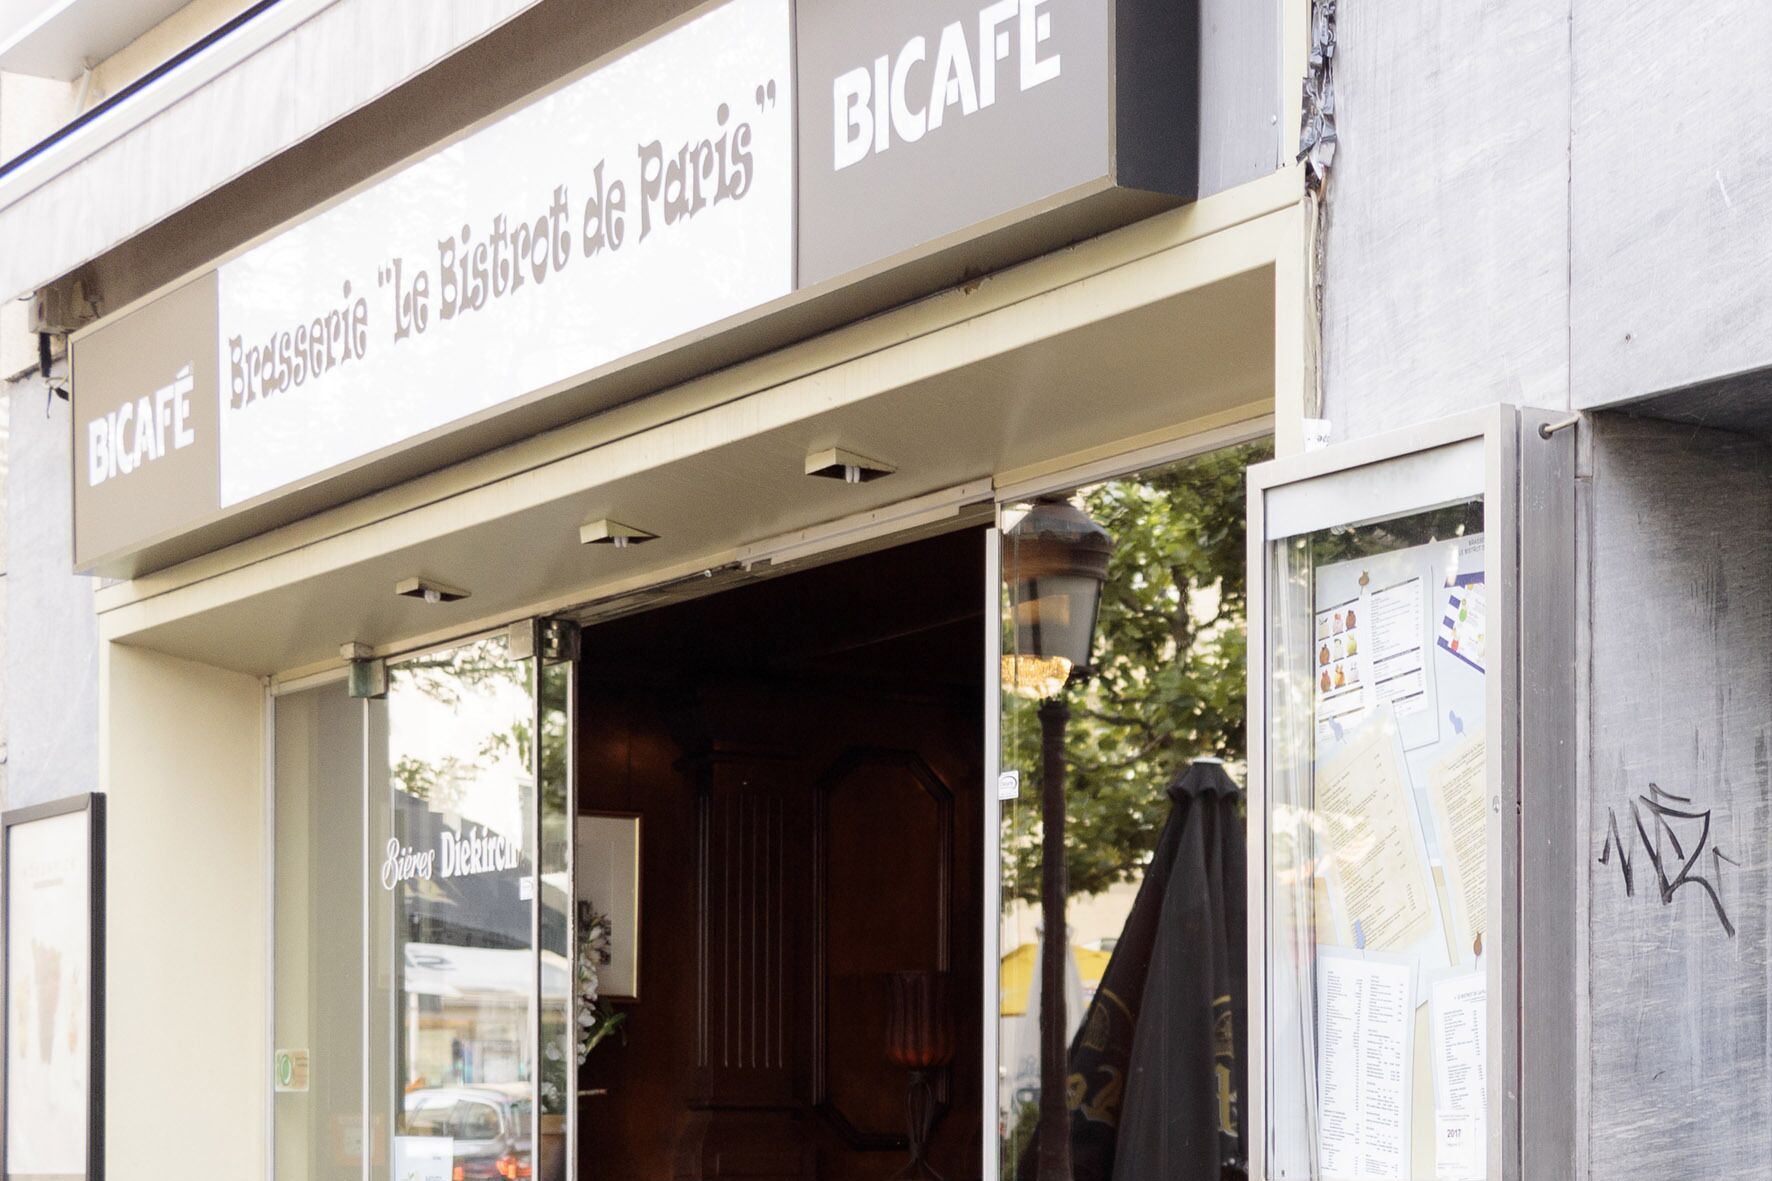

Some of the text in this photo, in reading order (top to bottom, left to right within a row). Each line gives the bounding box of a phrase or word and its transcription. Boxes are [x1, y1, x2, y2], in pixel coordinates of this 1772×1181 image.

[228, 281, 368, 410] Brasserie
[439, 184, 571, 320] Bistrot
[582, 157, 625, 257] de
[88, 361, 195, 487] BICAFÉ
[382, 836, 436, 890] Bières
